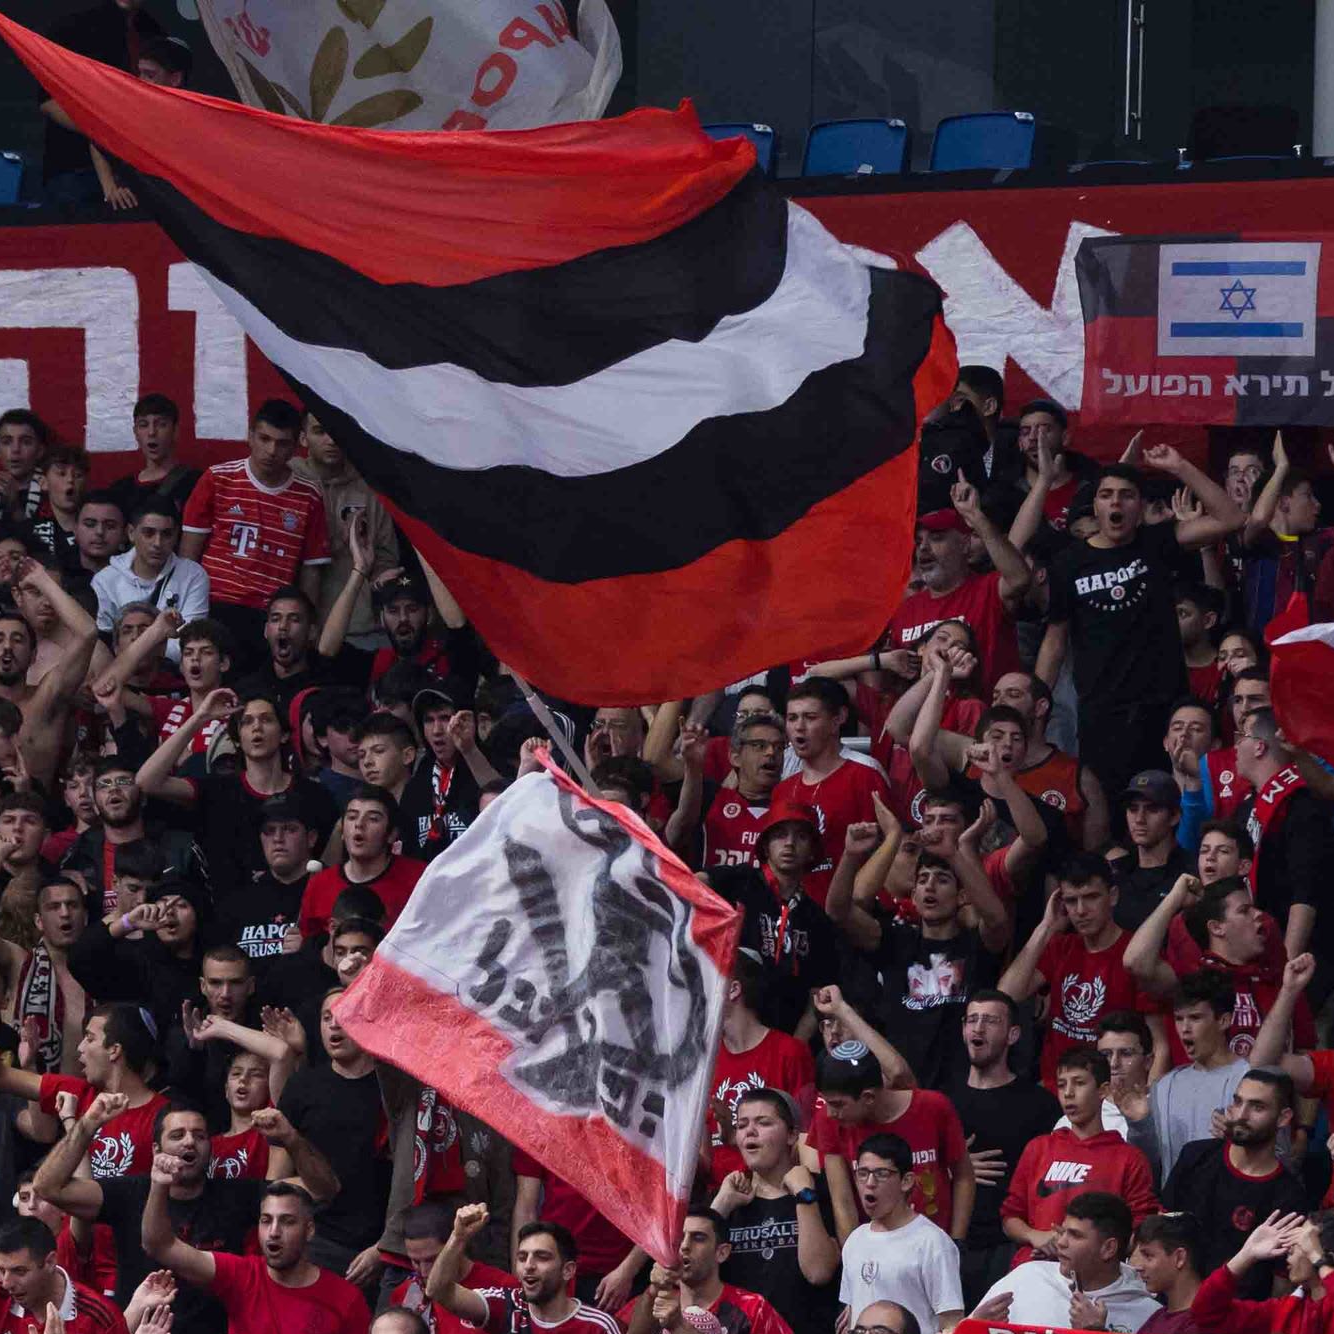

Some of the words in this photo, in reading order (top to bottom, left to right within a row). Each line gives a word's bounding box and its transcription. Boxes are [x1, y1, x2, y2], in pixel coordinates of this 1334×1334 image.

[1102, 367, 1212, 397] הפועל
[1225, 370, 1310, 397] תירא
[1074, 558, 1149, 596] HAPOEL
[1044, 1160, 1093, 1183] NIKE
[729, 1220, 800, 1241] JERUSALE
